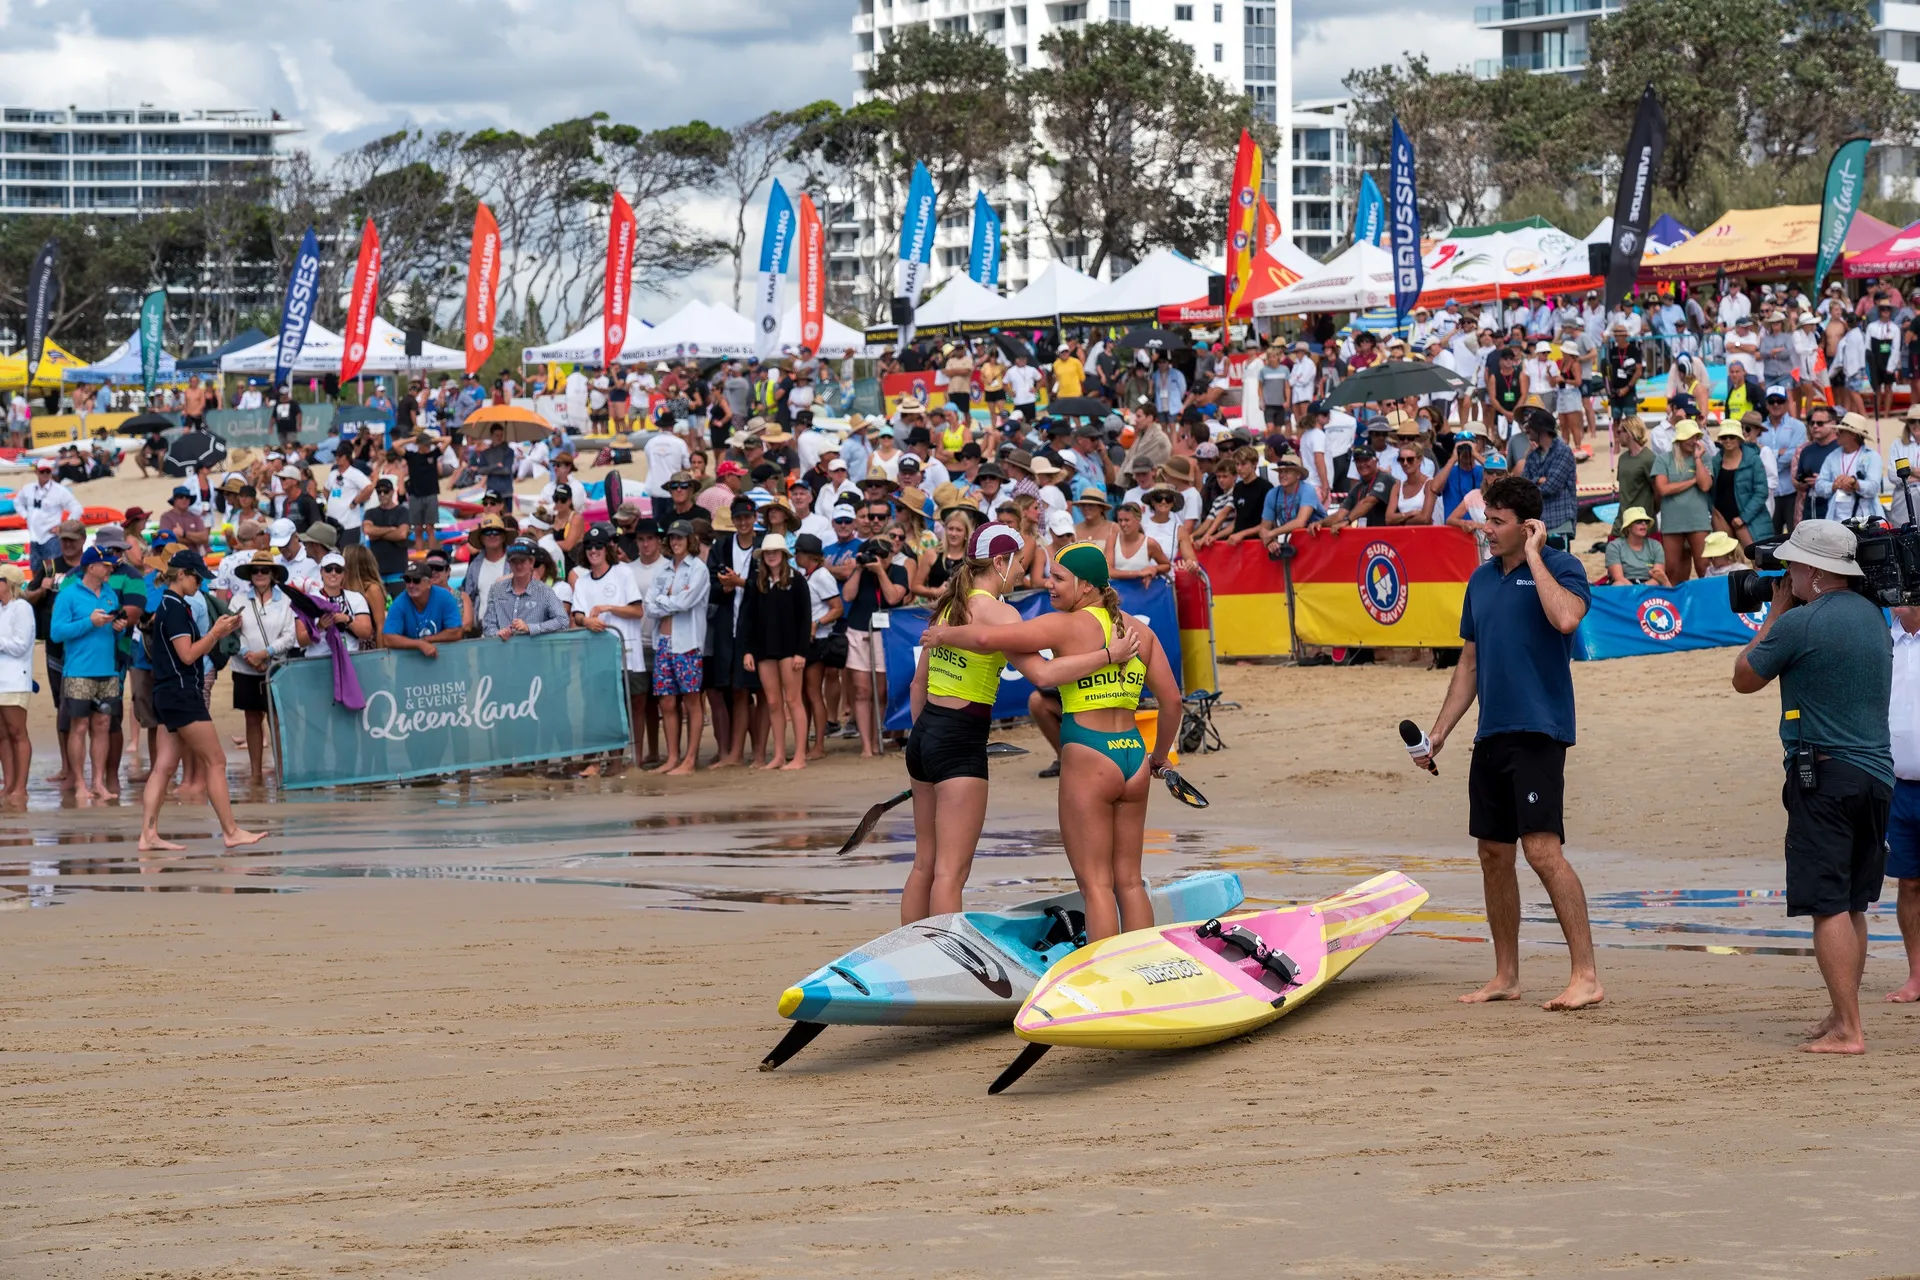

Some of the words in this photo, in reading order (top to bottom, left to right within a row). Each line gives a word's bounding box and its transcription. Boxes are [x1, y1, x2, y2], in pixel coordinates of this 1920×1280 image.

[1833, 158, 1857, 215] Coast
[767, 209, 789, 303] MARSHALLING
[905, 195, 931, 294] MARSHALLING
[981, 220, 994, 285] SHALLING
[477, 233, 496, 324] MARSHALLING
[612, 220, 630, 315] MARSHALLING
[807, 222, 819, 313] MARSHALLING
[1366, 543, 1396, 559] SURF
[1359, 585, 1378, 618] LIFE
[1380, 585, 1407, 623] SAVING
[1643, 597, 1671, 608] SURF
[1640, 620, 1656, 639] LIFE
[930, 646, 968, 669] USSIES
[362, 675, 542, 740] Queensland
[404, 681, 466, 698] TOURISM
[405, 698, 415, 710] &
[418, 692, 467, 708] EVENTS
[1107, 738, 1142, 750] AVOCA
[1131, 959, 1203, 985] DOLPHIN
